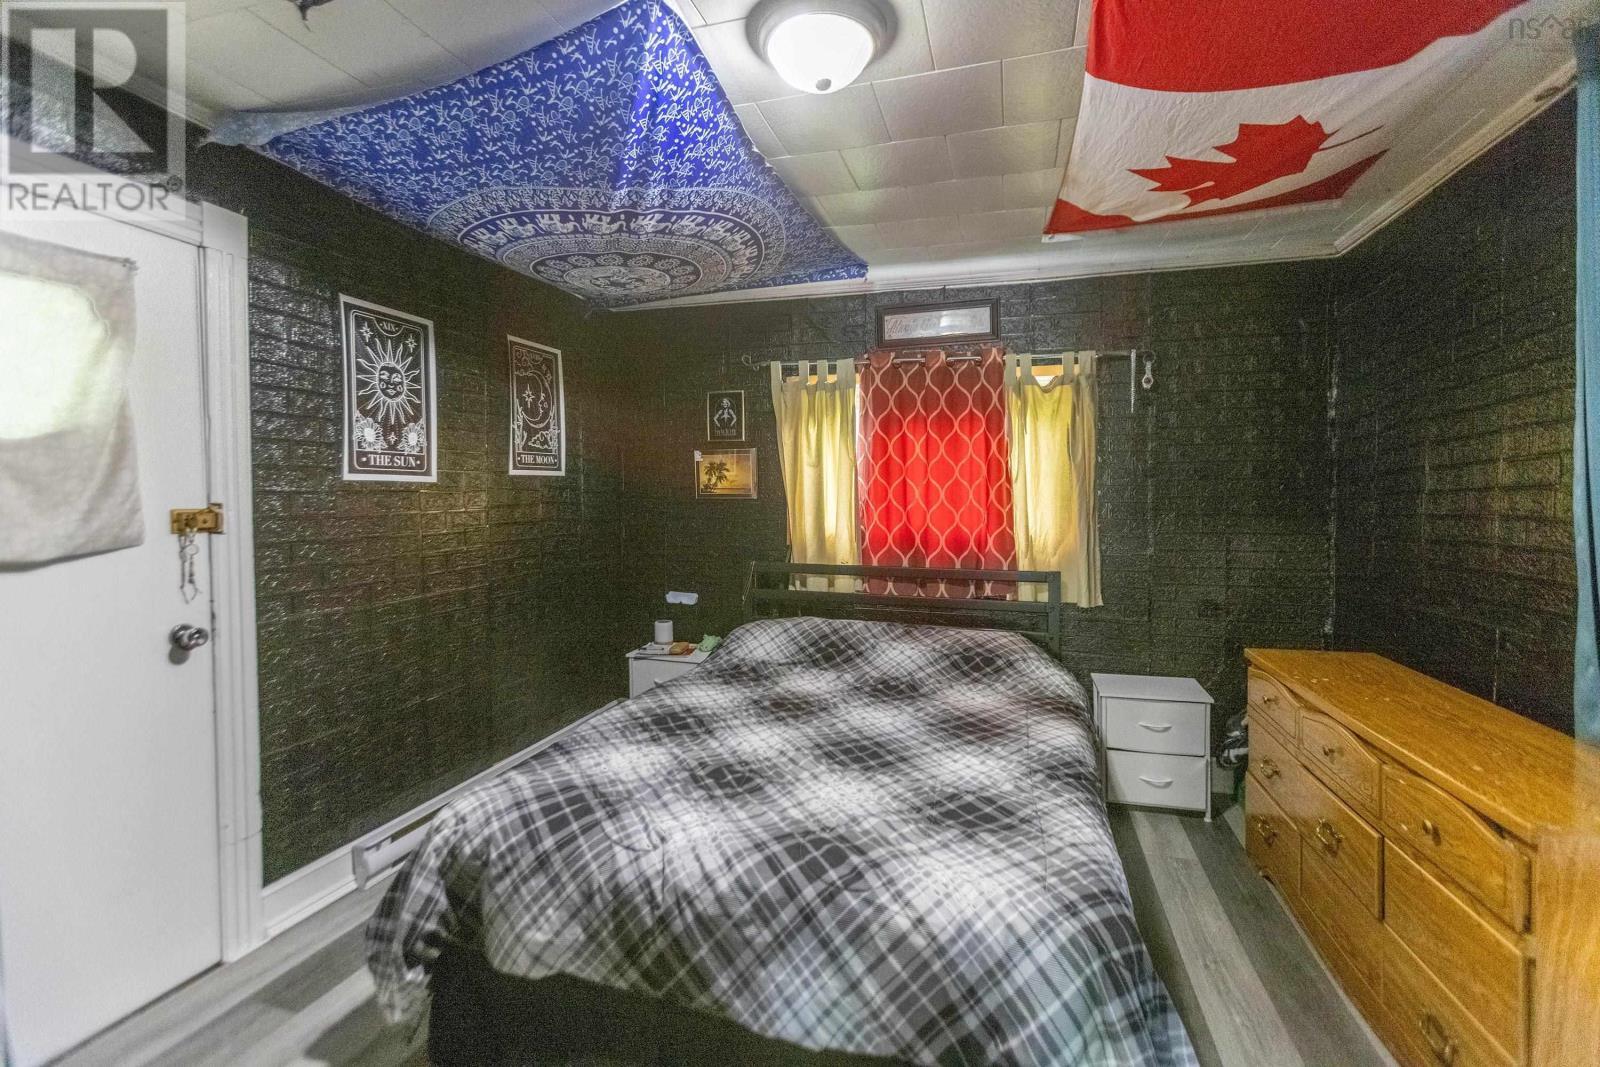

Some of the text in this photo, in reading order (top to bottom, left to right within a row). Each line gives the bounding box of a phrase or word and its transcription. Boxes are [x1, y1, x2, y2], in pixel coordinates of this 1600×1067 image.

[368, 454, 416, 468] THE SUN
[520, 454, 555, 465] THE MOON
